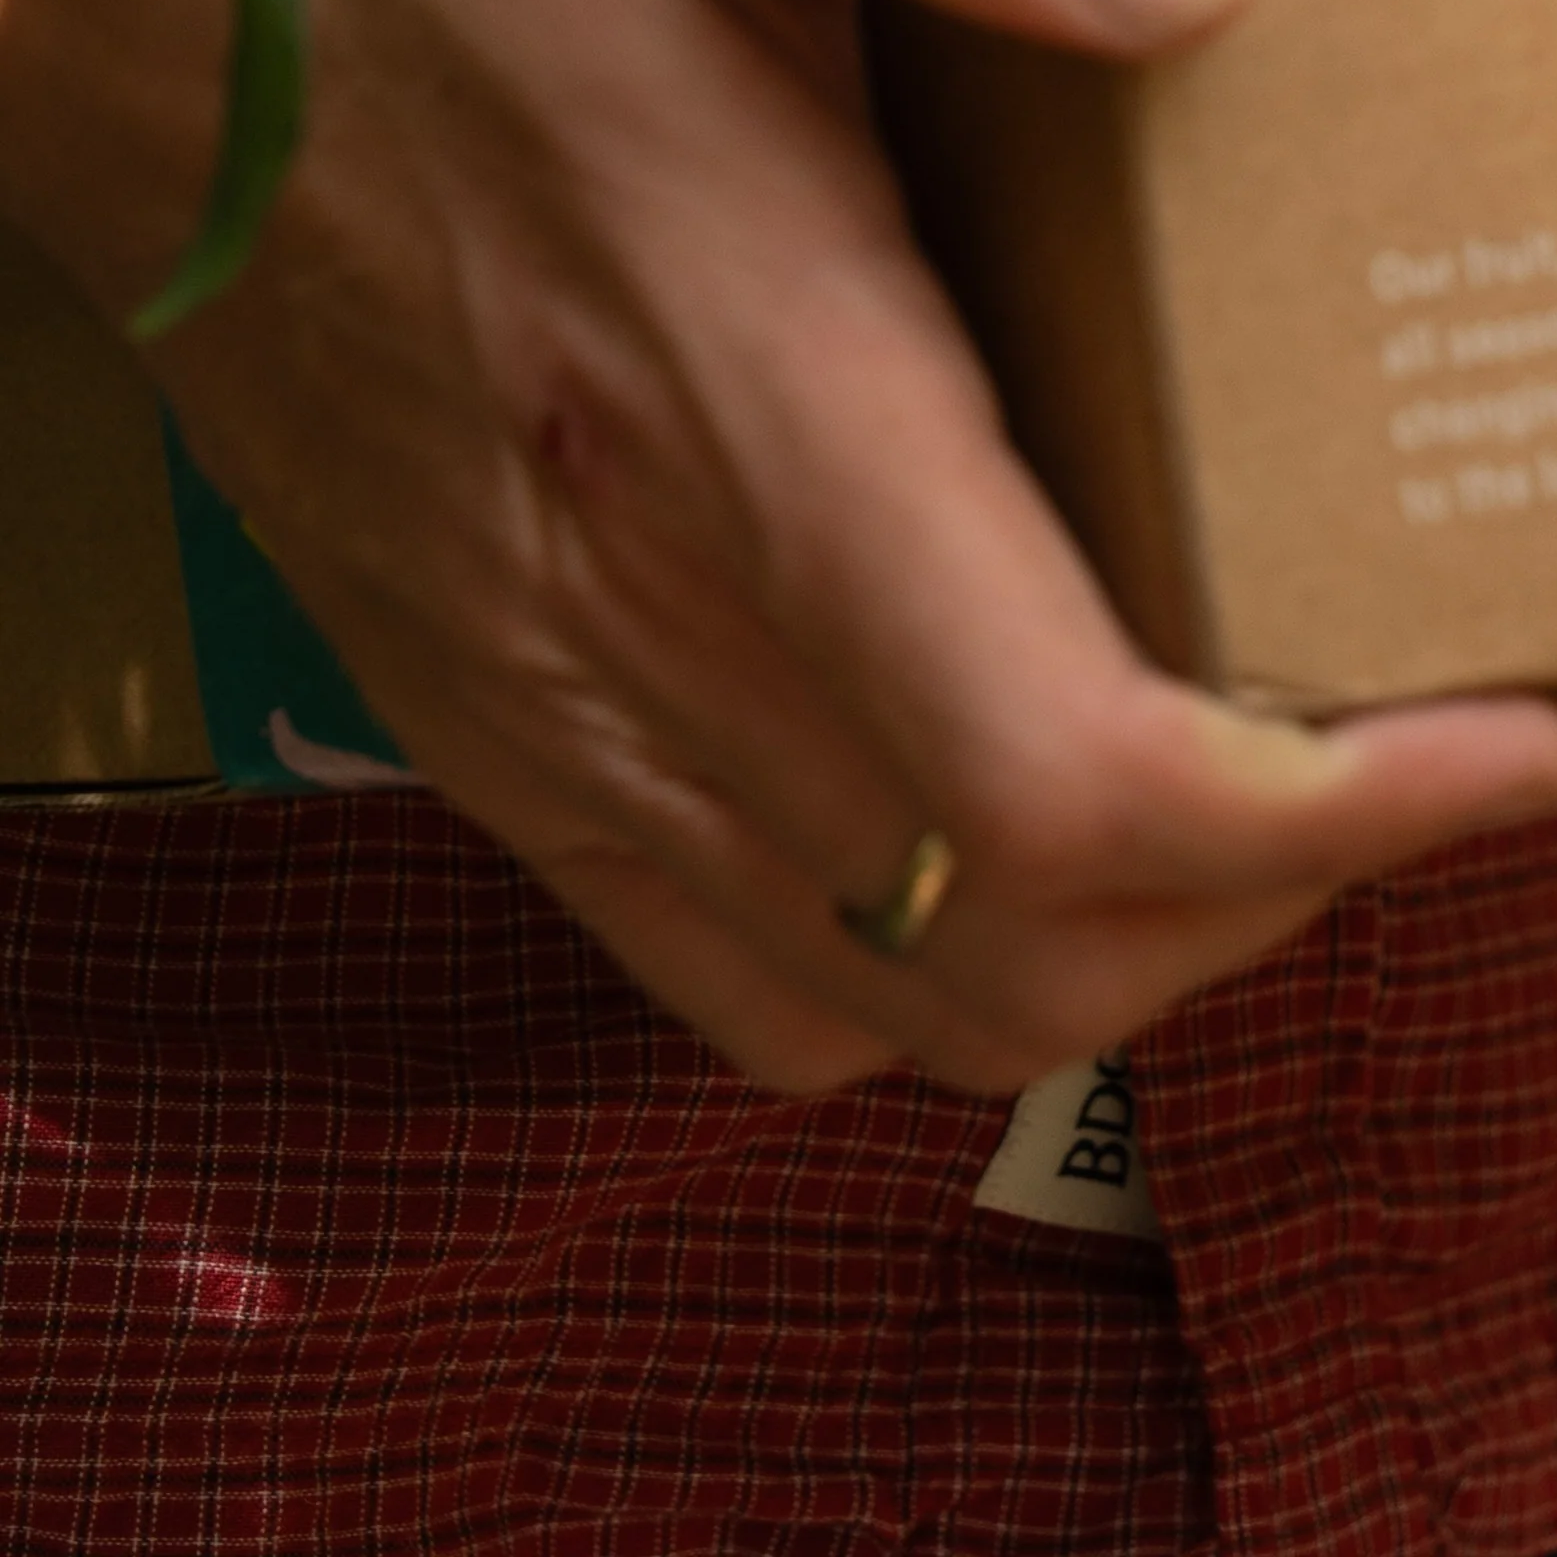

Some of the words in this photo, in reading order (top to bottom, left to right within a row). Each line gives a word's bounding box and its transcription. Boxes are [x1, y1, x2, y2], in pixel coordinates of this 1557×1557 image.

[1369, 249, 1455, 302] Our
[1381, 321, 1436, 379] all
[1397, 477, 1449, 525] to
[1455, 462, 1530, 516] the
